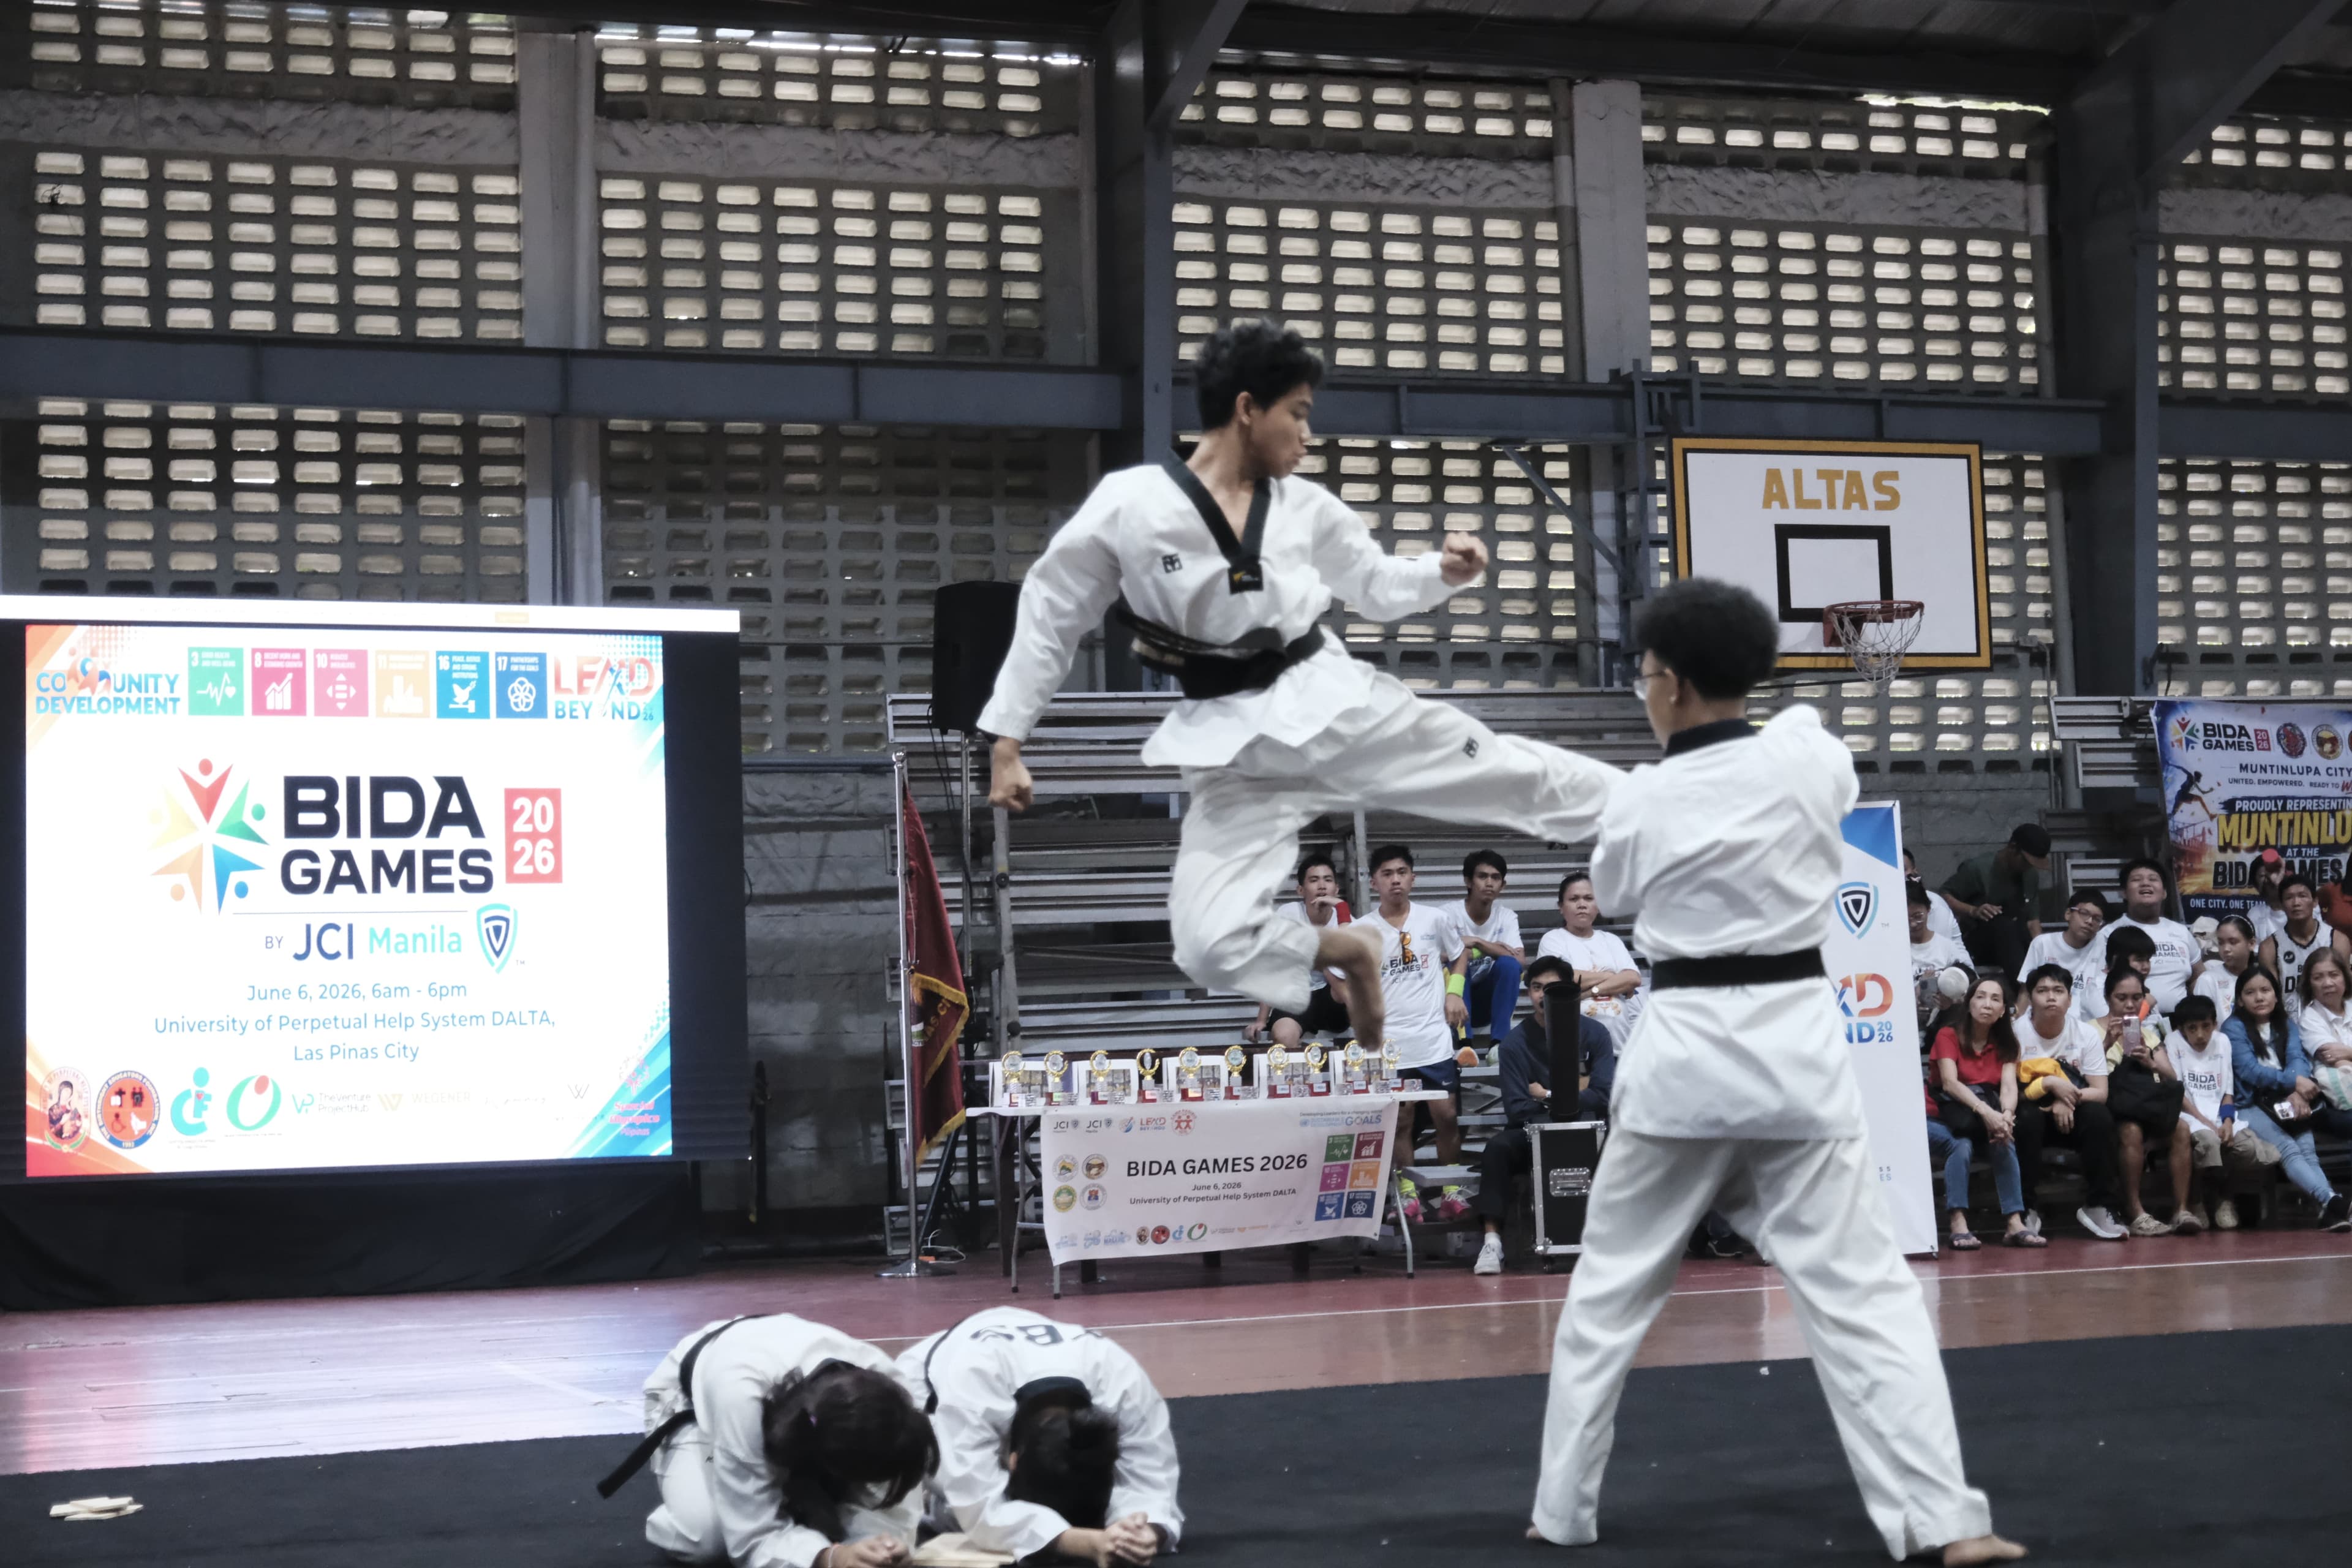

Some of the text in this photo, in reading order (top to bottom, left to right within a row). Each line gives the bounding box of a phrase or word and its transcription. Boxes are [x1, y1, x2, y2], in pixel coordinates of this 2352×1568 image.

[1762, 468, 1901, 511] ALTAS
[191, 652, 198, 666] 3
[254, 652, 262, 668] 8
[316, 654, 328, 668] 10
[438, 655, 450, 671] 16
[497, 657, 508, 671] 17
[36, 672, 179, 694] COUNITY
[36, 696, 181, 715] DEVELOPMENT
[555, 701, 641, 720] BEYND
[2202, 722, 2252, 740] BIDA
[2256, 730, 2267, 740] 20
[2203, 739, 2255, 752] GAMES
[2257, 739, 2269, 749] 26
[2239, 763, 2352, 778] MUNTINLUPA CITY
[2257, 778, 2305, 787] EMPOWERED.
[2341, 780, 2352, 793] W
[284, 775, 486, 839] BIDA
[2236, 799, 2283, 812] PROUDLY
[513, 797, 554, 833] 20
[513, 839, 556, 875] 26
[2286, 848, 2320, 857] AT THE
[281, 848, 494, 895] GAMES
[2213, 858, 2342, 889] BID AMES
[2190, 898, 2206, 908] ONE
[2207, 899, 2228, 909] CITY.
[2229, 899, 2245, 910] ONE
[265, 922, 462, 961] BY JCI Manila
[1390, 964, 1421, 976] GAMES
[247, 985, 292, 1001] June
[298, 984, 313, 1002] 6,
[318, 983, 366, 1001] 2026,
[371, 982, 410, 999] 6am
[428, 981, 467, 1001] 6pm
[154, 1009, 556, 1036] University of Perpetual Help System DALTA,
[1877, 1021, 1892, 1032] 20
[1878, 1032, 1893, 1042] 26
[294, 1041, 420, 1063] Las Pinas City
[2188, 1072, 2216, 1084] BIDA
[1053, 1121, 1069, 1130] JCI
[1086, 1120, 1102, 1129] JCI
[1345, 1115, 1382, 1126] GOALS
[1127, 1153, 1308, 1177] BIDA GAMES 2026
[1191, 1183, 1212, 1191] June
[1222, 1182, 1242, 1190] 2026
[1129, 1196, 1172, 1205] University
[1182, 1194, 1221, 1204] Perpetual
[1223, 1193, 1242, 1201] Help
[1243, 1191, 1272, 1200] System
[1273, 1188, 1297, 1197] DALTA
